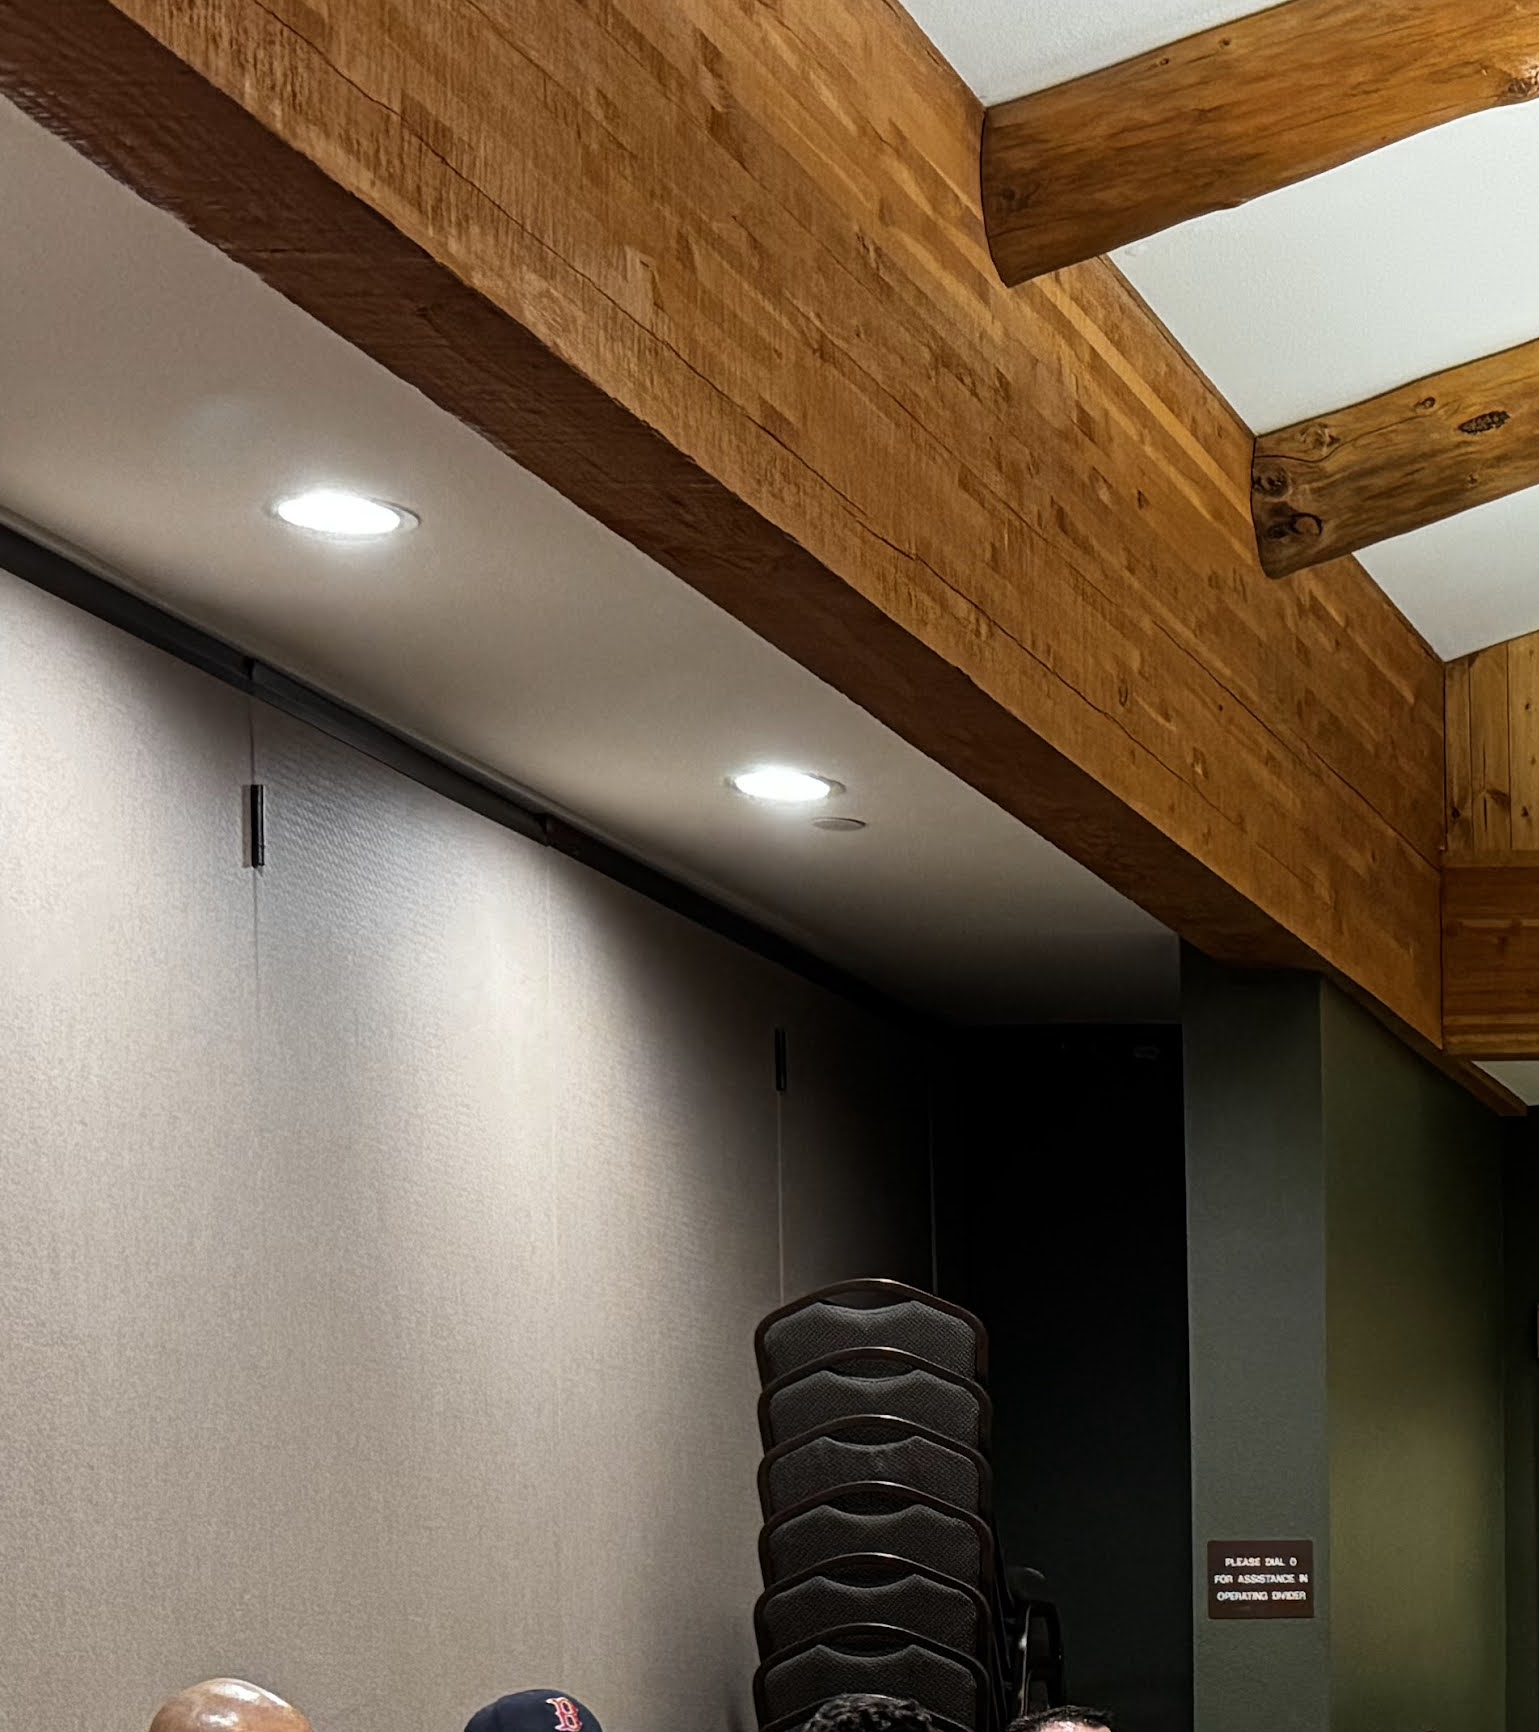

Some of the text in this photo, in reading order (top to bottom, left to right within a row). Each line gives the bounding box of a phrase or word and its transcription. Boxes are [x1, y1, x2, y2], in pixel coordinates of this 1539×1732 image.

[1225, 1557, 1261, 1567] PLEASE
[1264, 1557, 1286, 1567] DIAL
[1214, 1574, 1309, 1584] FOR ASSISTANCE IN
[1216, 1591, 1268, 1601] OPERATING
[545, 1697, 583, 1732] B
